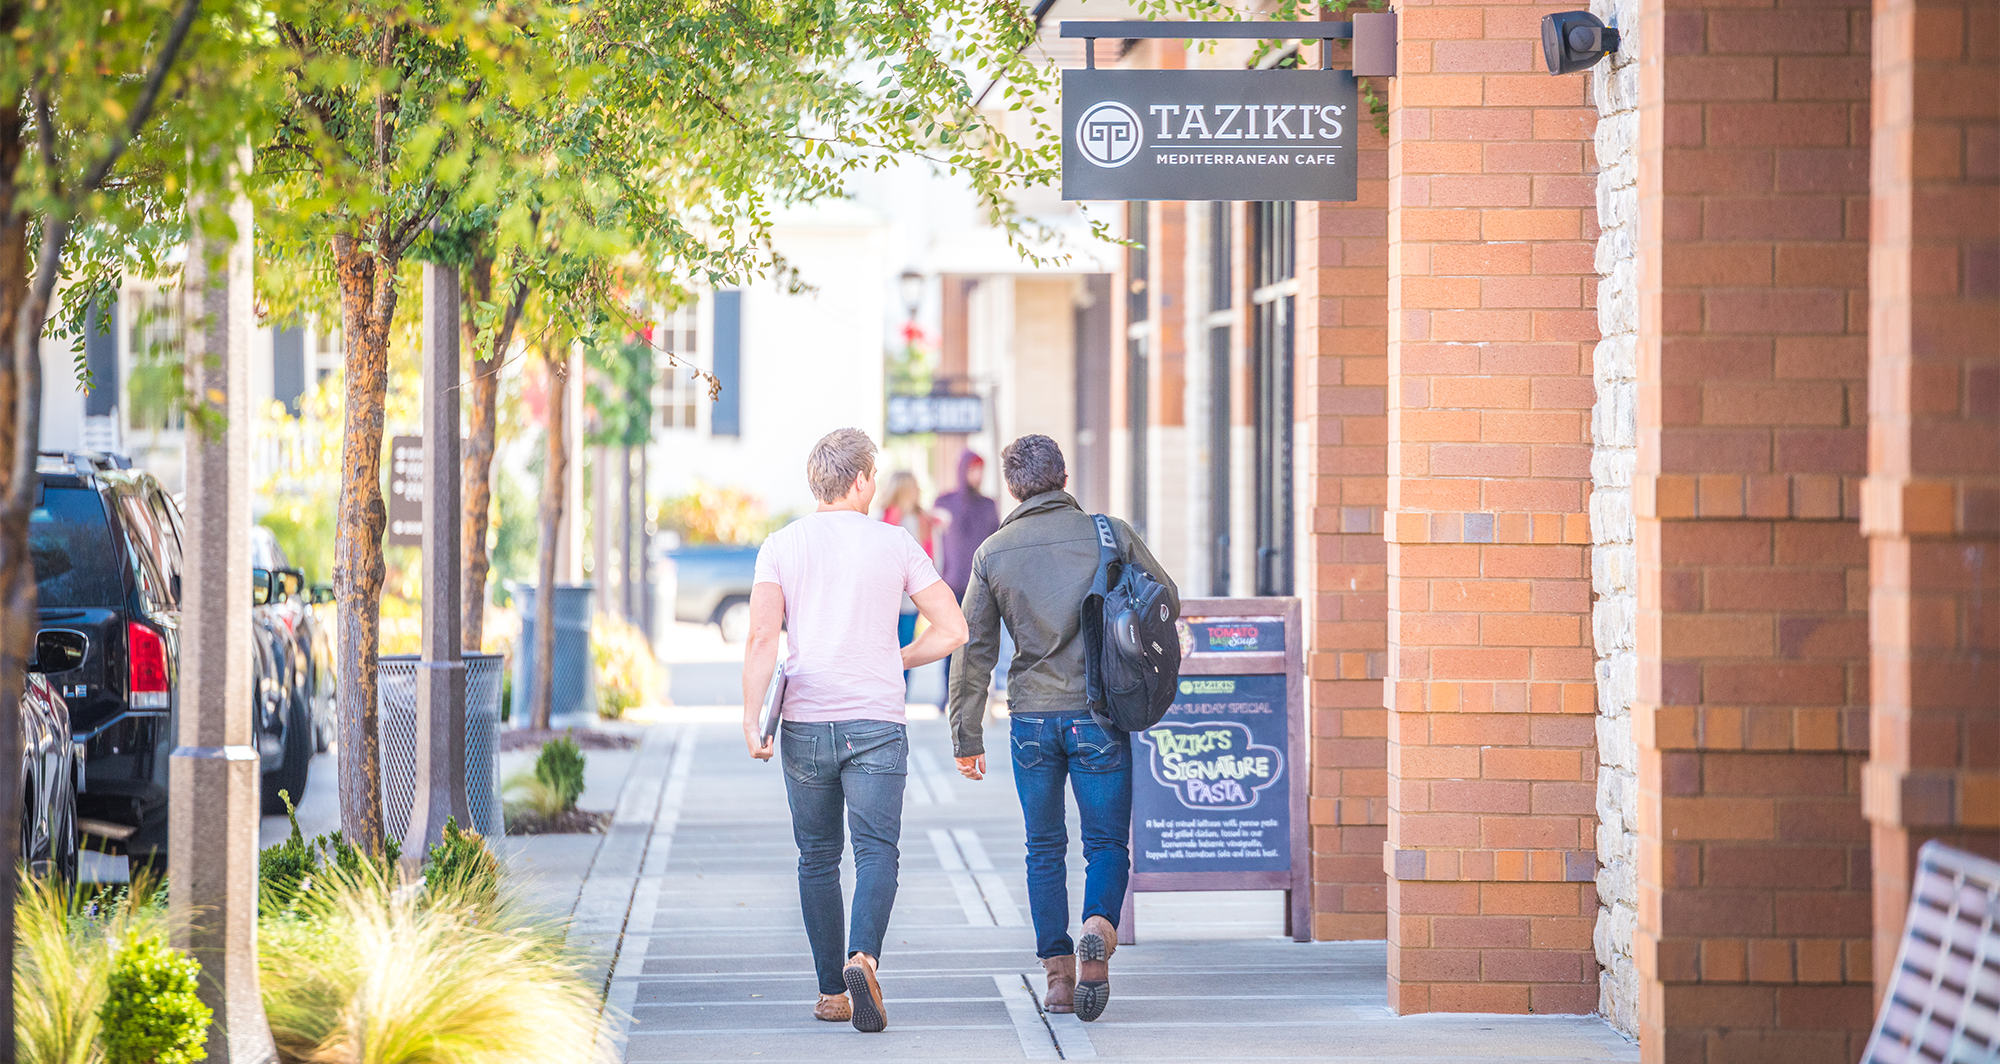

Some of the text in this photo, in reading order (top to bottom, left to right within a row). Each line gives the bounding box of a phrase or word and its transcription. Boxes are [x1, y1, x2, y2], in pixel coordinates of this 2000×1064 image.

[1150, 105, 1343, 140] TAZIKI'S
[1157, 154, 1336, 165] MEDITERRANEAN CAFE
[1207, 627, 1259, 639] TOMATO
[1166, 703, 1226, 715] AY-SUNDAY
[1187, 779, 1248, 804] PASTA
